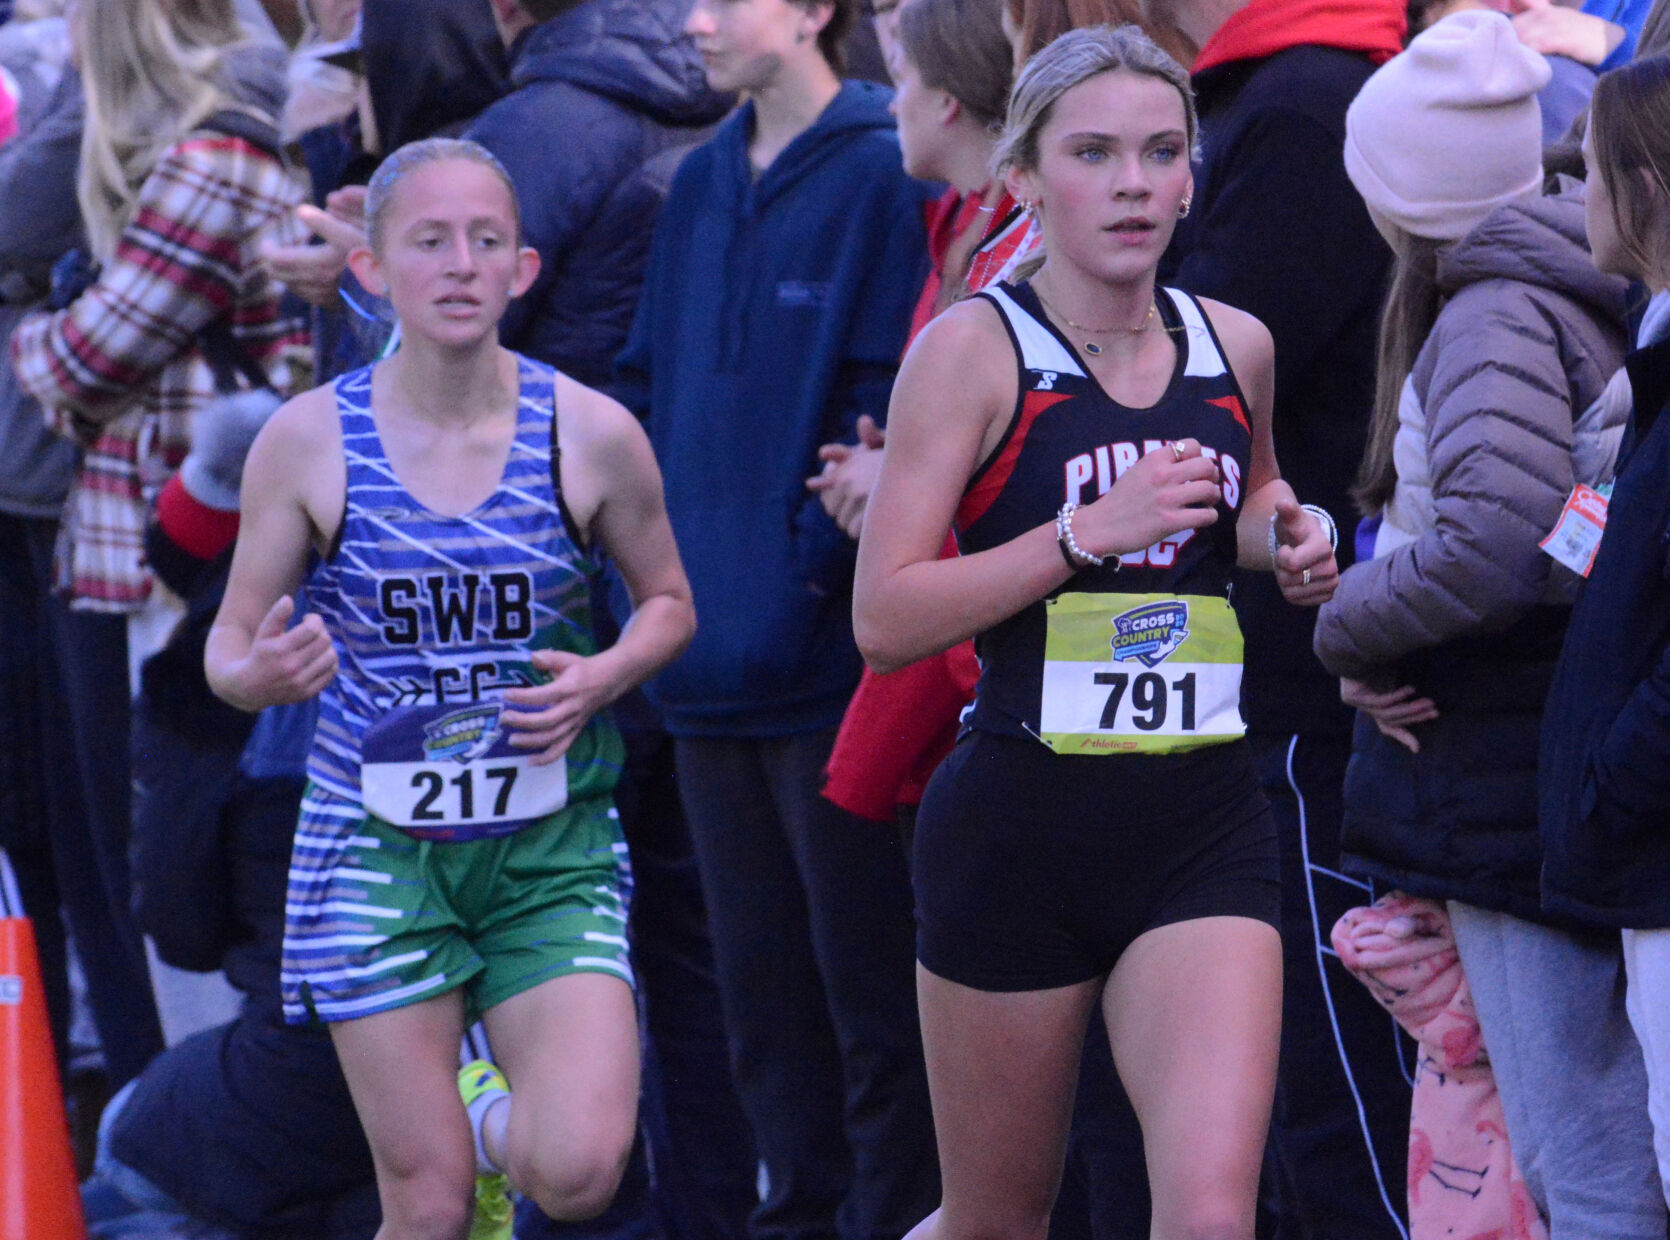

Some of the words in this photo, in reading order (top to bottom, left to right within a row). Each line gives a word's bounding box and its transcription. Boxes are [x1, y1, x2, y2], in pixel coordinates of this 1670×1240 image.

[1064, 438, 1241, 511] PIRS
[379, 571, 533, 646] SWB
[1132, 612, 1174, 631] CROSS
[1112, 626, 1170, 648] COUNTRY
[1094, 672, 1196, 731] 791
[411, 766, 518, 820] 217
